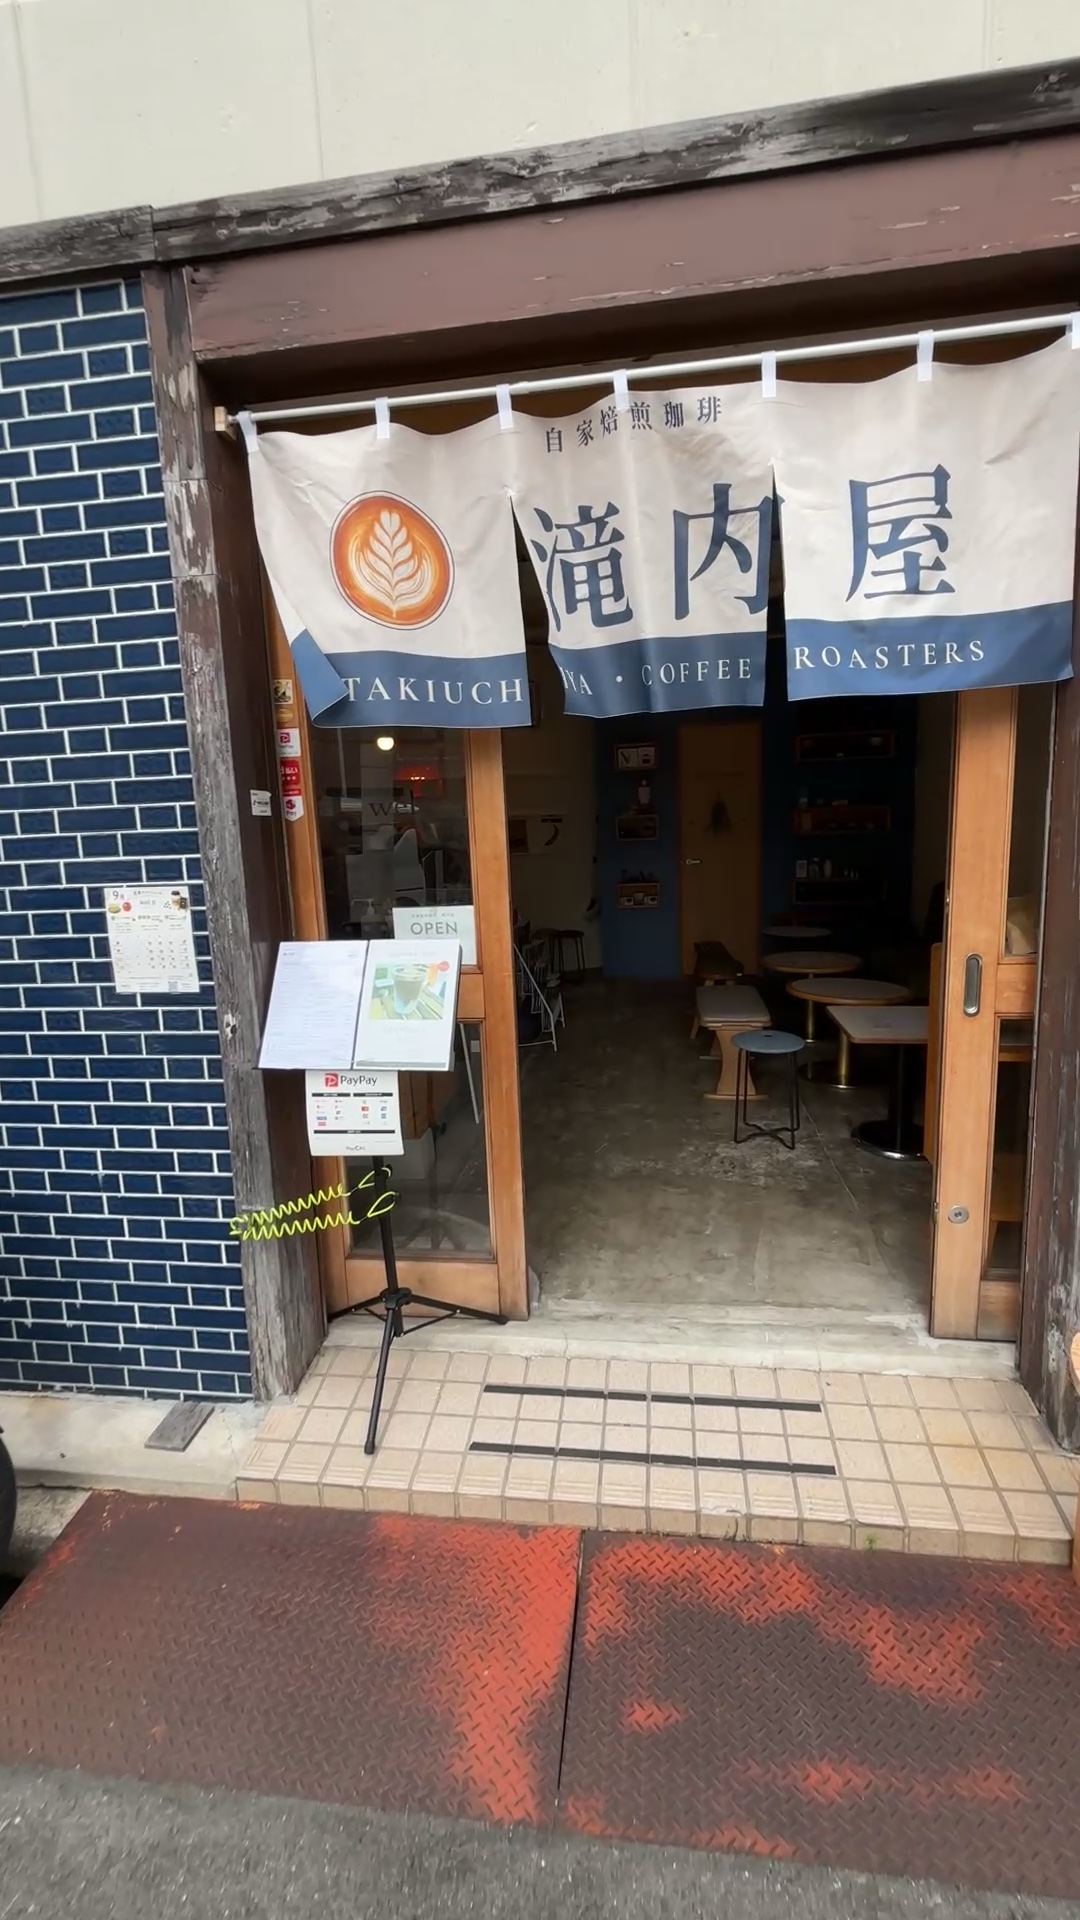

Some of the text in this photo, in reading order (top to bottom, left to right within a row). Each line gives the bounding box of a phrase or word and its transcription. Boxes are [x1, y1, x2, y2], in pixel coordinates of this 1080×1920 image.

[546, 396, 722, 453] 自家焙煎珈琲
[641, 658, 751, 686] COFFEE
[793, 640, 985, 670] ROASTERS
[410, 921, 458, 935] OPEN
[340, 1075, 377, 1087] PayPay
